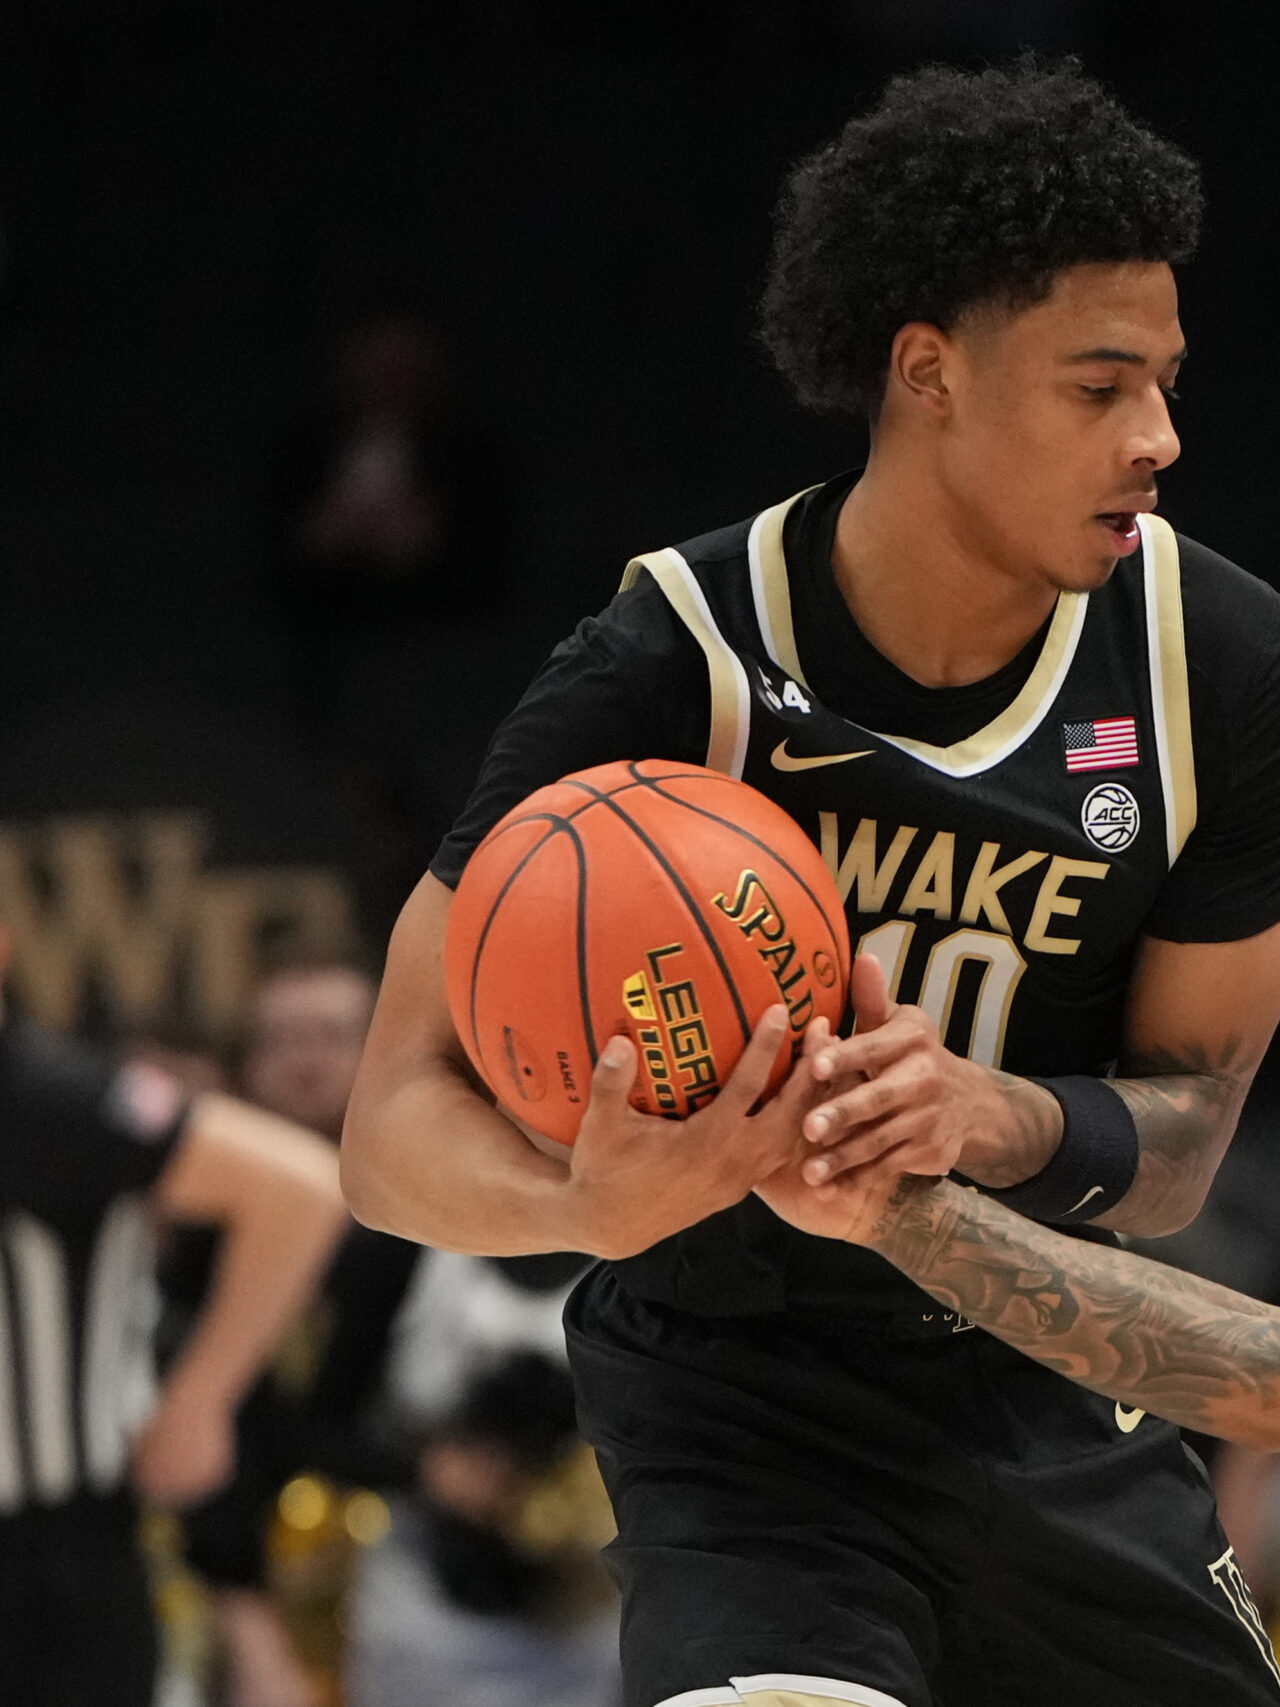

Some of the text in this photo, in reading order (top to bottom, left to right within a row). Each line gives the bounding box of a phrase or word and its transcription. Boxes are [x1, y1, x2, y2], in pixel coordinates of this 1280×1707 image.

[1093, 806, 1134, 821] ACC
[818, 811, 1110, 955] WAKE
[636, 1026, 682, 1120] 100
